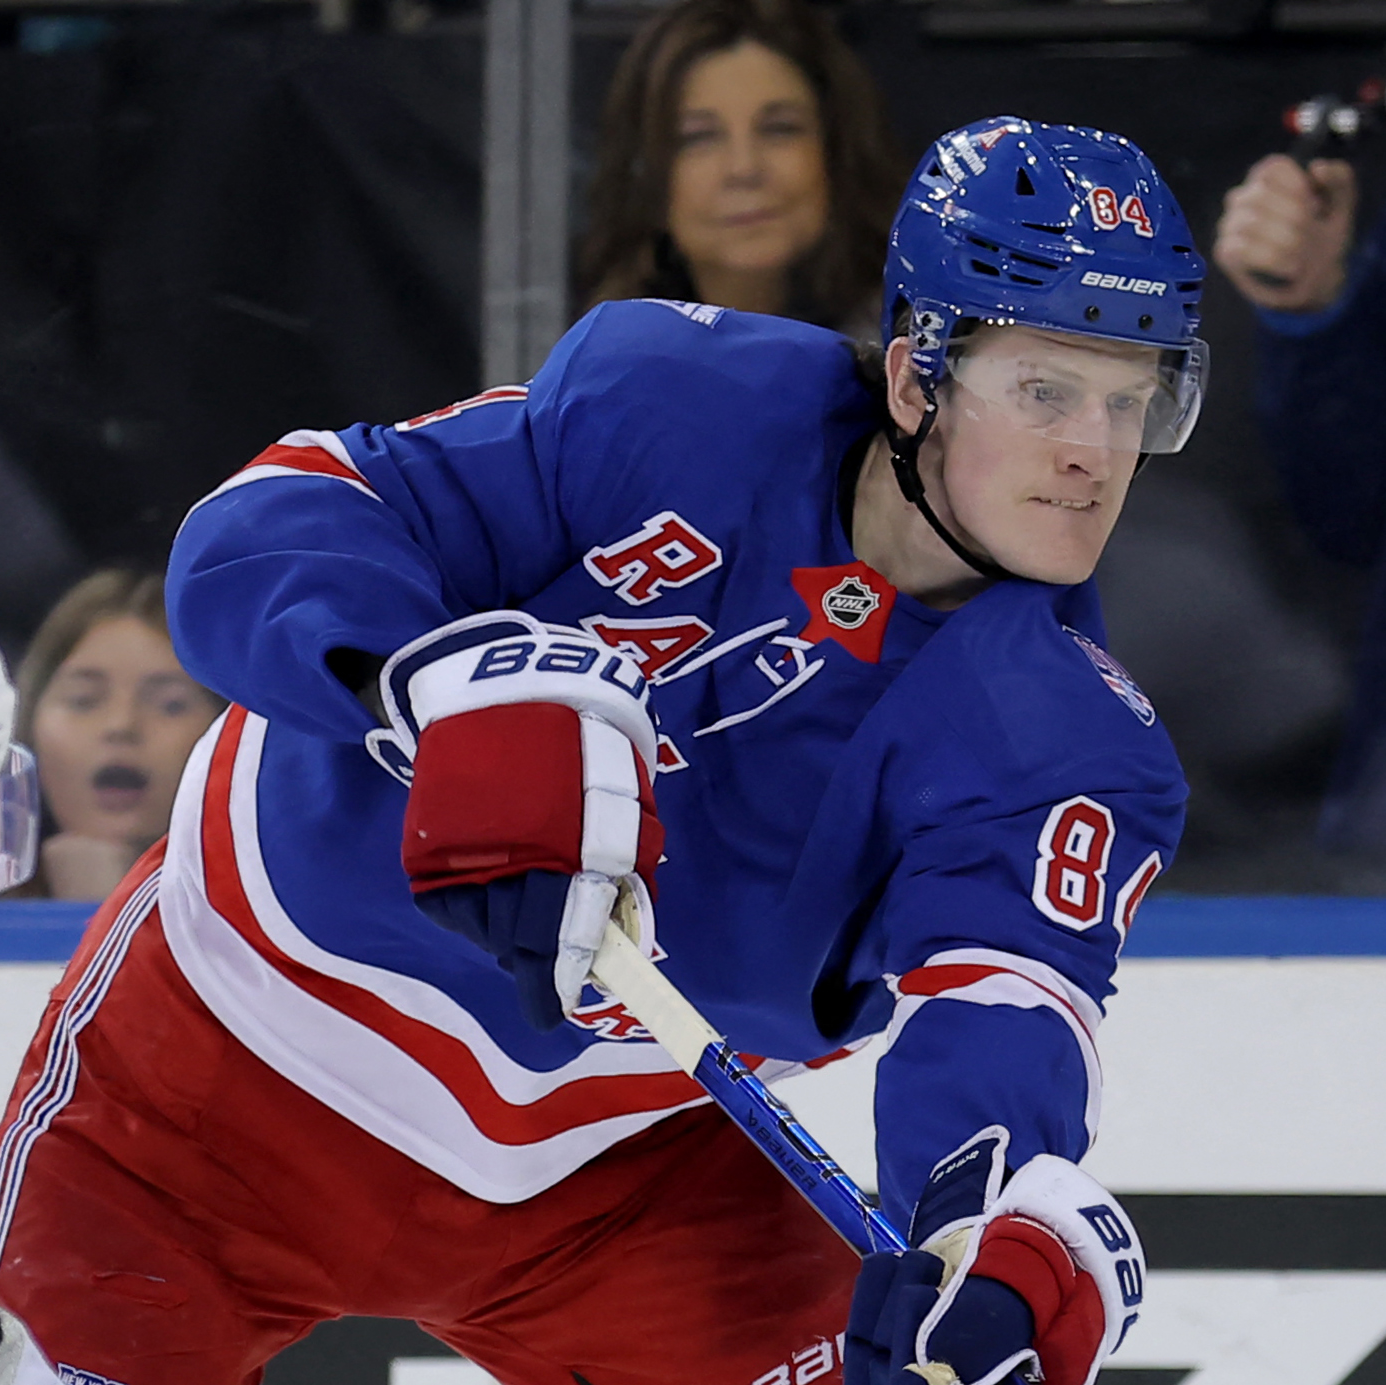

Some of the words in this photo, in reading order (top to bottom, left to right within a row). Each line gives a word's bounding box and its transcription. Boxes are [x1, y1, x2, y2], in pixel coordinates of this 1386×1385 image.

[949, 130, 988, 176] njamin
[1088, 186, 1154, 238] 84
[830, 598, 865, 610] NHL
